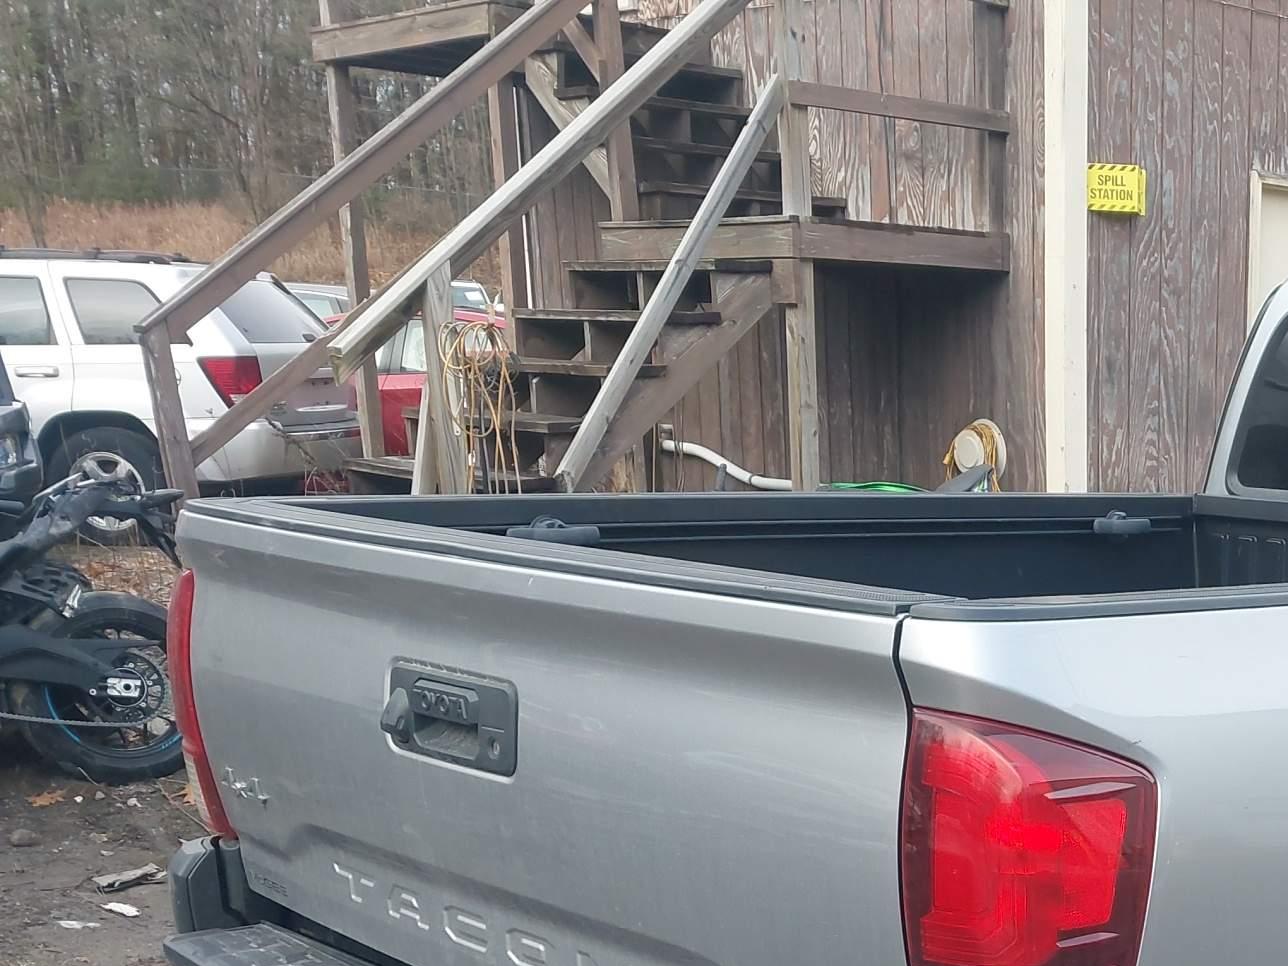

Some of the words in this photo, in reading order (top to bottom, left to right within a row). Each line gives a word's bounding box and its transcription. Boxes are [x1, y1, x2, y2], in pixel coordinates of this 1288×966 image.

[1097, 174, 1126, 187] SPILL
[1089, 187, 1133, 201] STATION
[411, 688, 469, 720] TOYOTA
